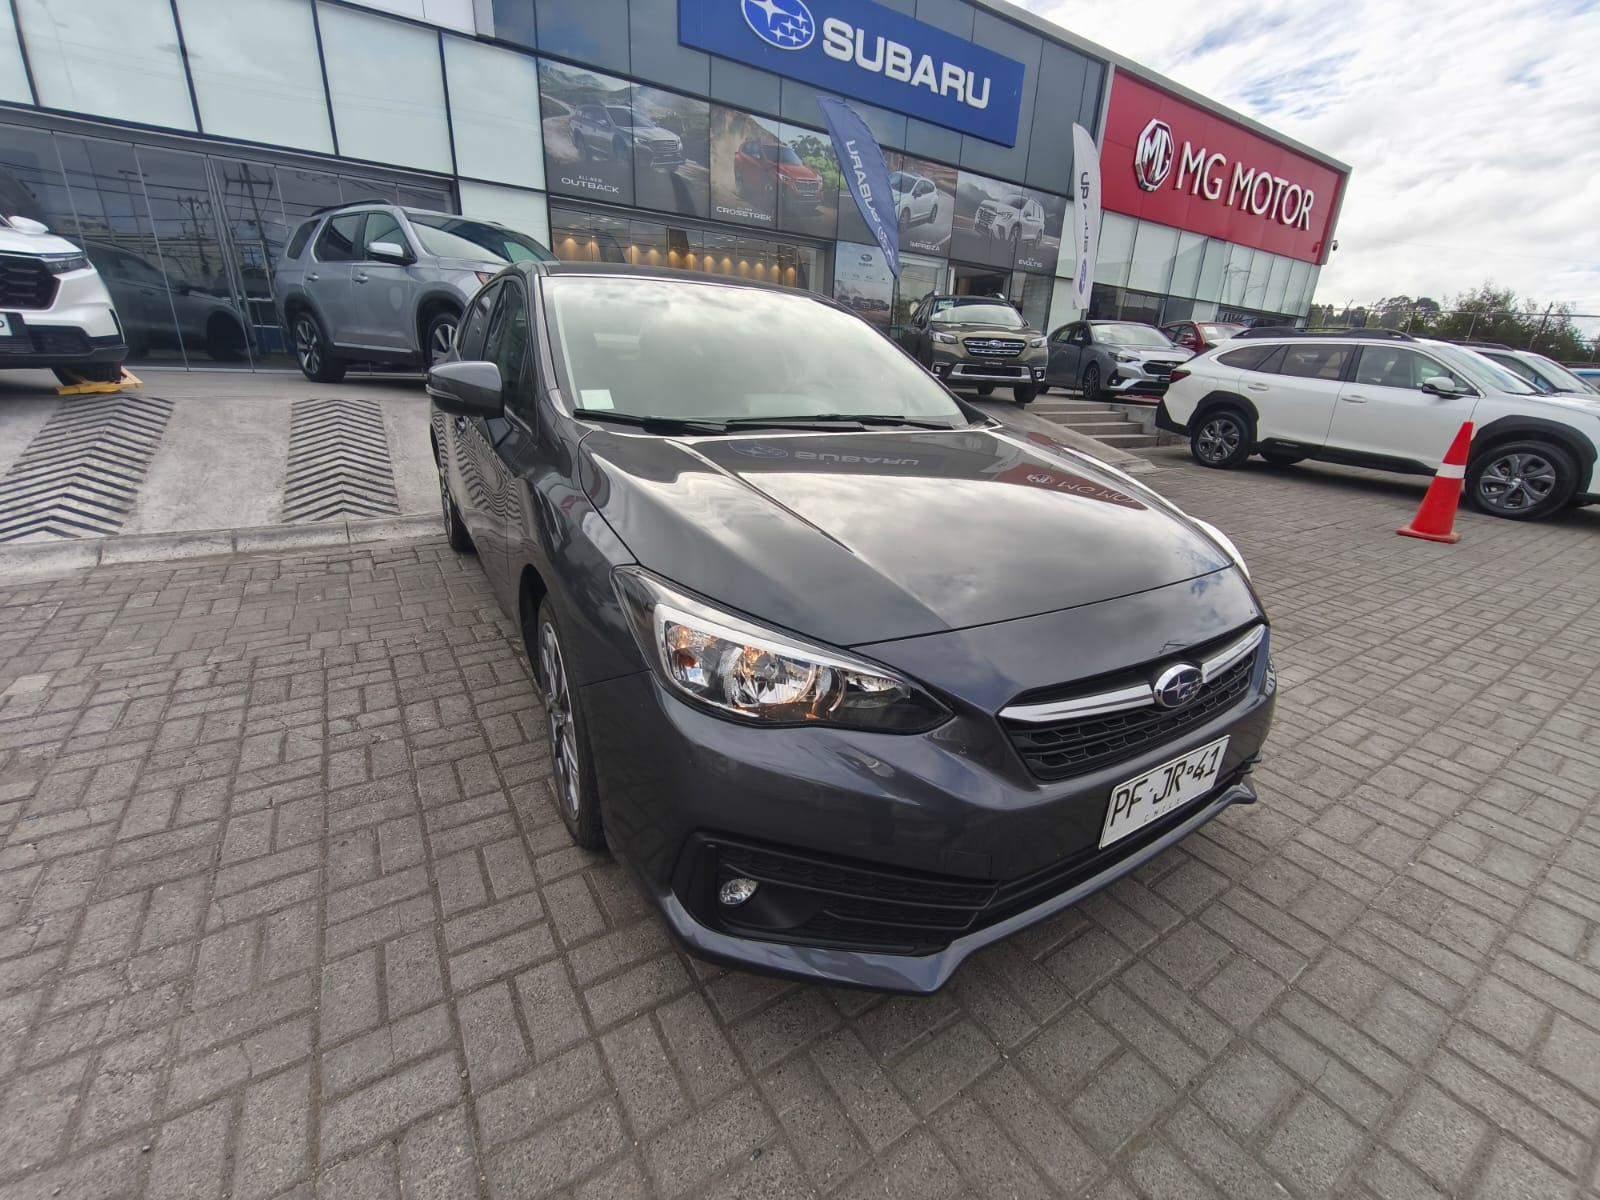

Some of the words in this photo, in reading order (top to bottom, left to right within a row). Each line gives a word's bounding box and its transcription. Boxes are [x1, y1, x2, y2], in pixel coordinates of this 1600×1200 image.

[822, 17, 991, 110] SUBARU
[560, 177, 620, 194] OUTBACK
[1175, 141, 1227, 200] MG
[1226, 162, 1315, 231] MOTOR
[716, 206, 772, 222] CROSSTREK
